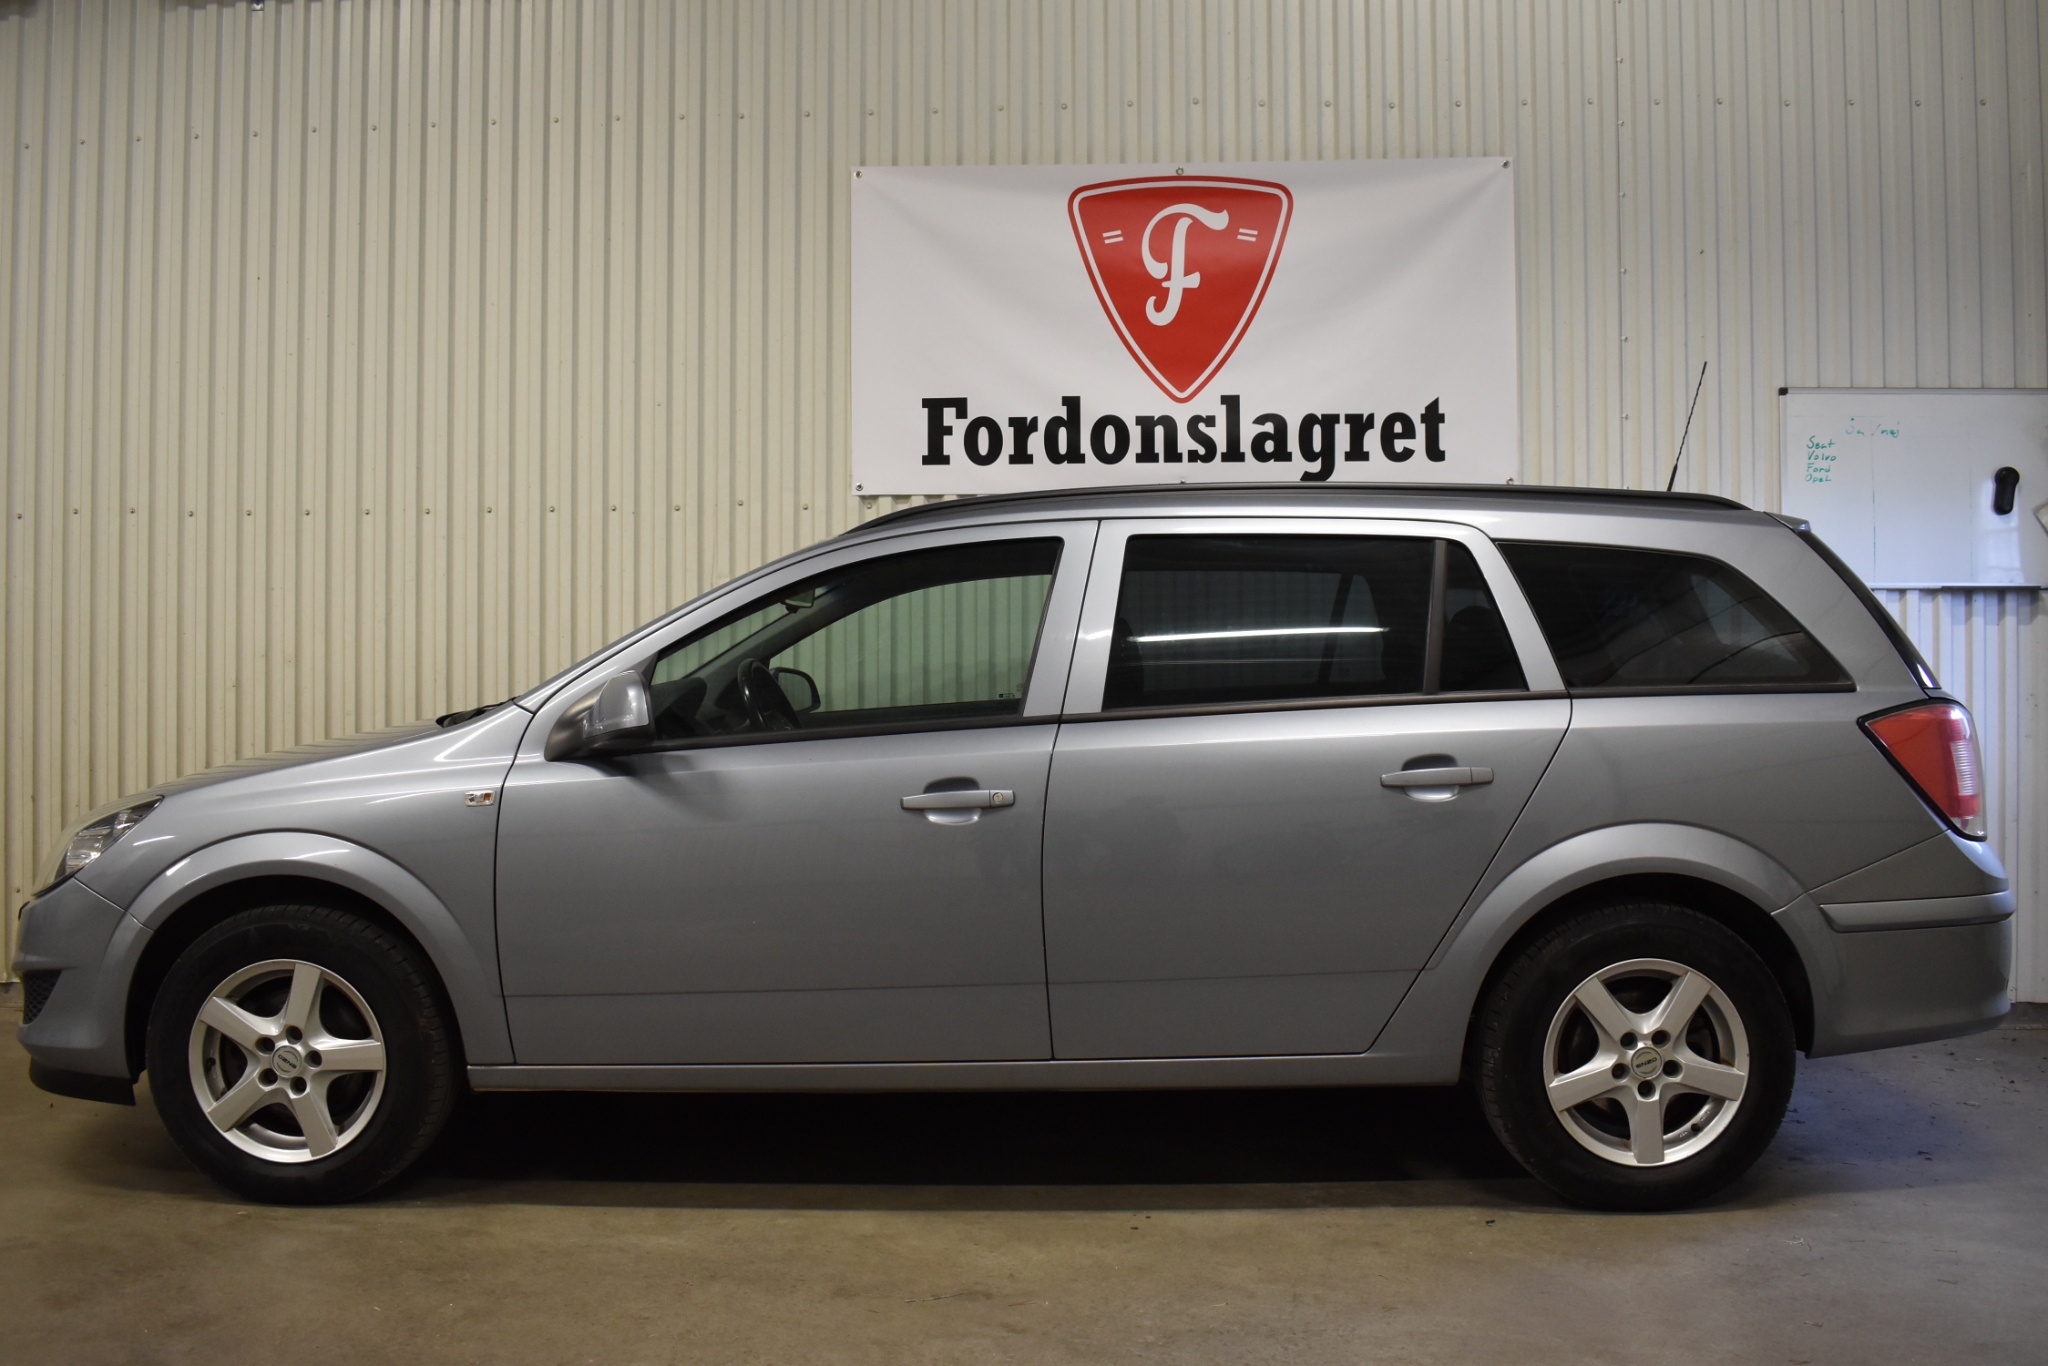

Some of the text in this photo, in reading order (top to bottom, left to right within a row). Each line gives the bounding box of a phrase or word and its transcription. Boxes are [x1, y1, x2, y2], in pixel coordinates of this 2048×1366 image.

[921, 394, 1447, 482] Fordonslagret
[1806, 435, 1836, 449] Seat
[1807, 450, 1837, 462] Volvo
[1806, 462, 1831, 473] Ford
[1636, 1057, 1657, 1068] ENZO
